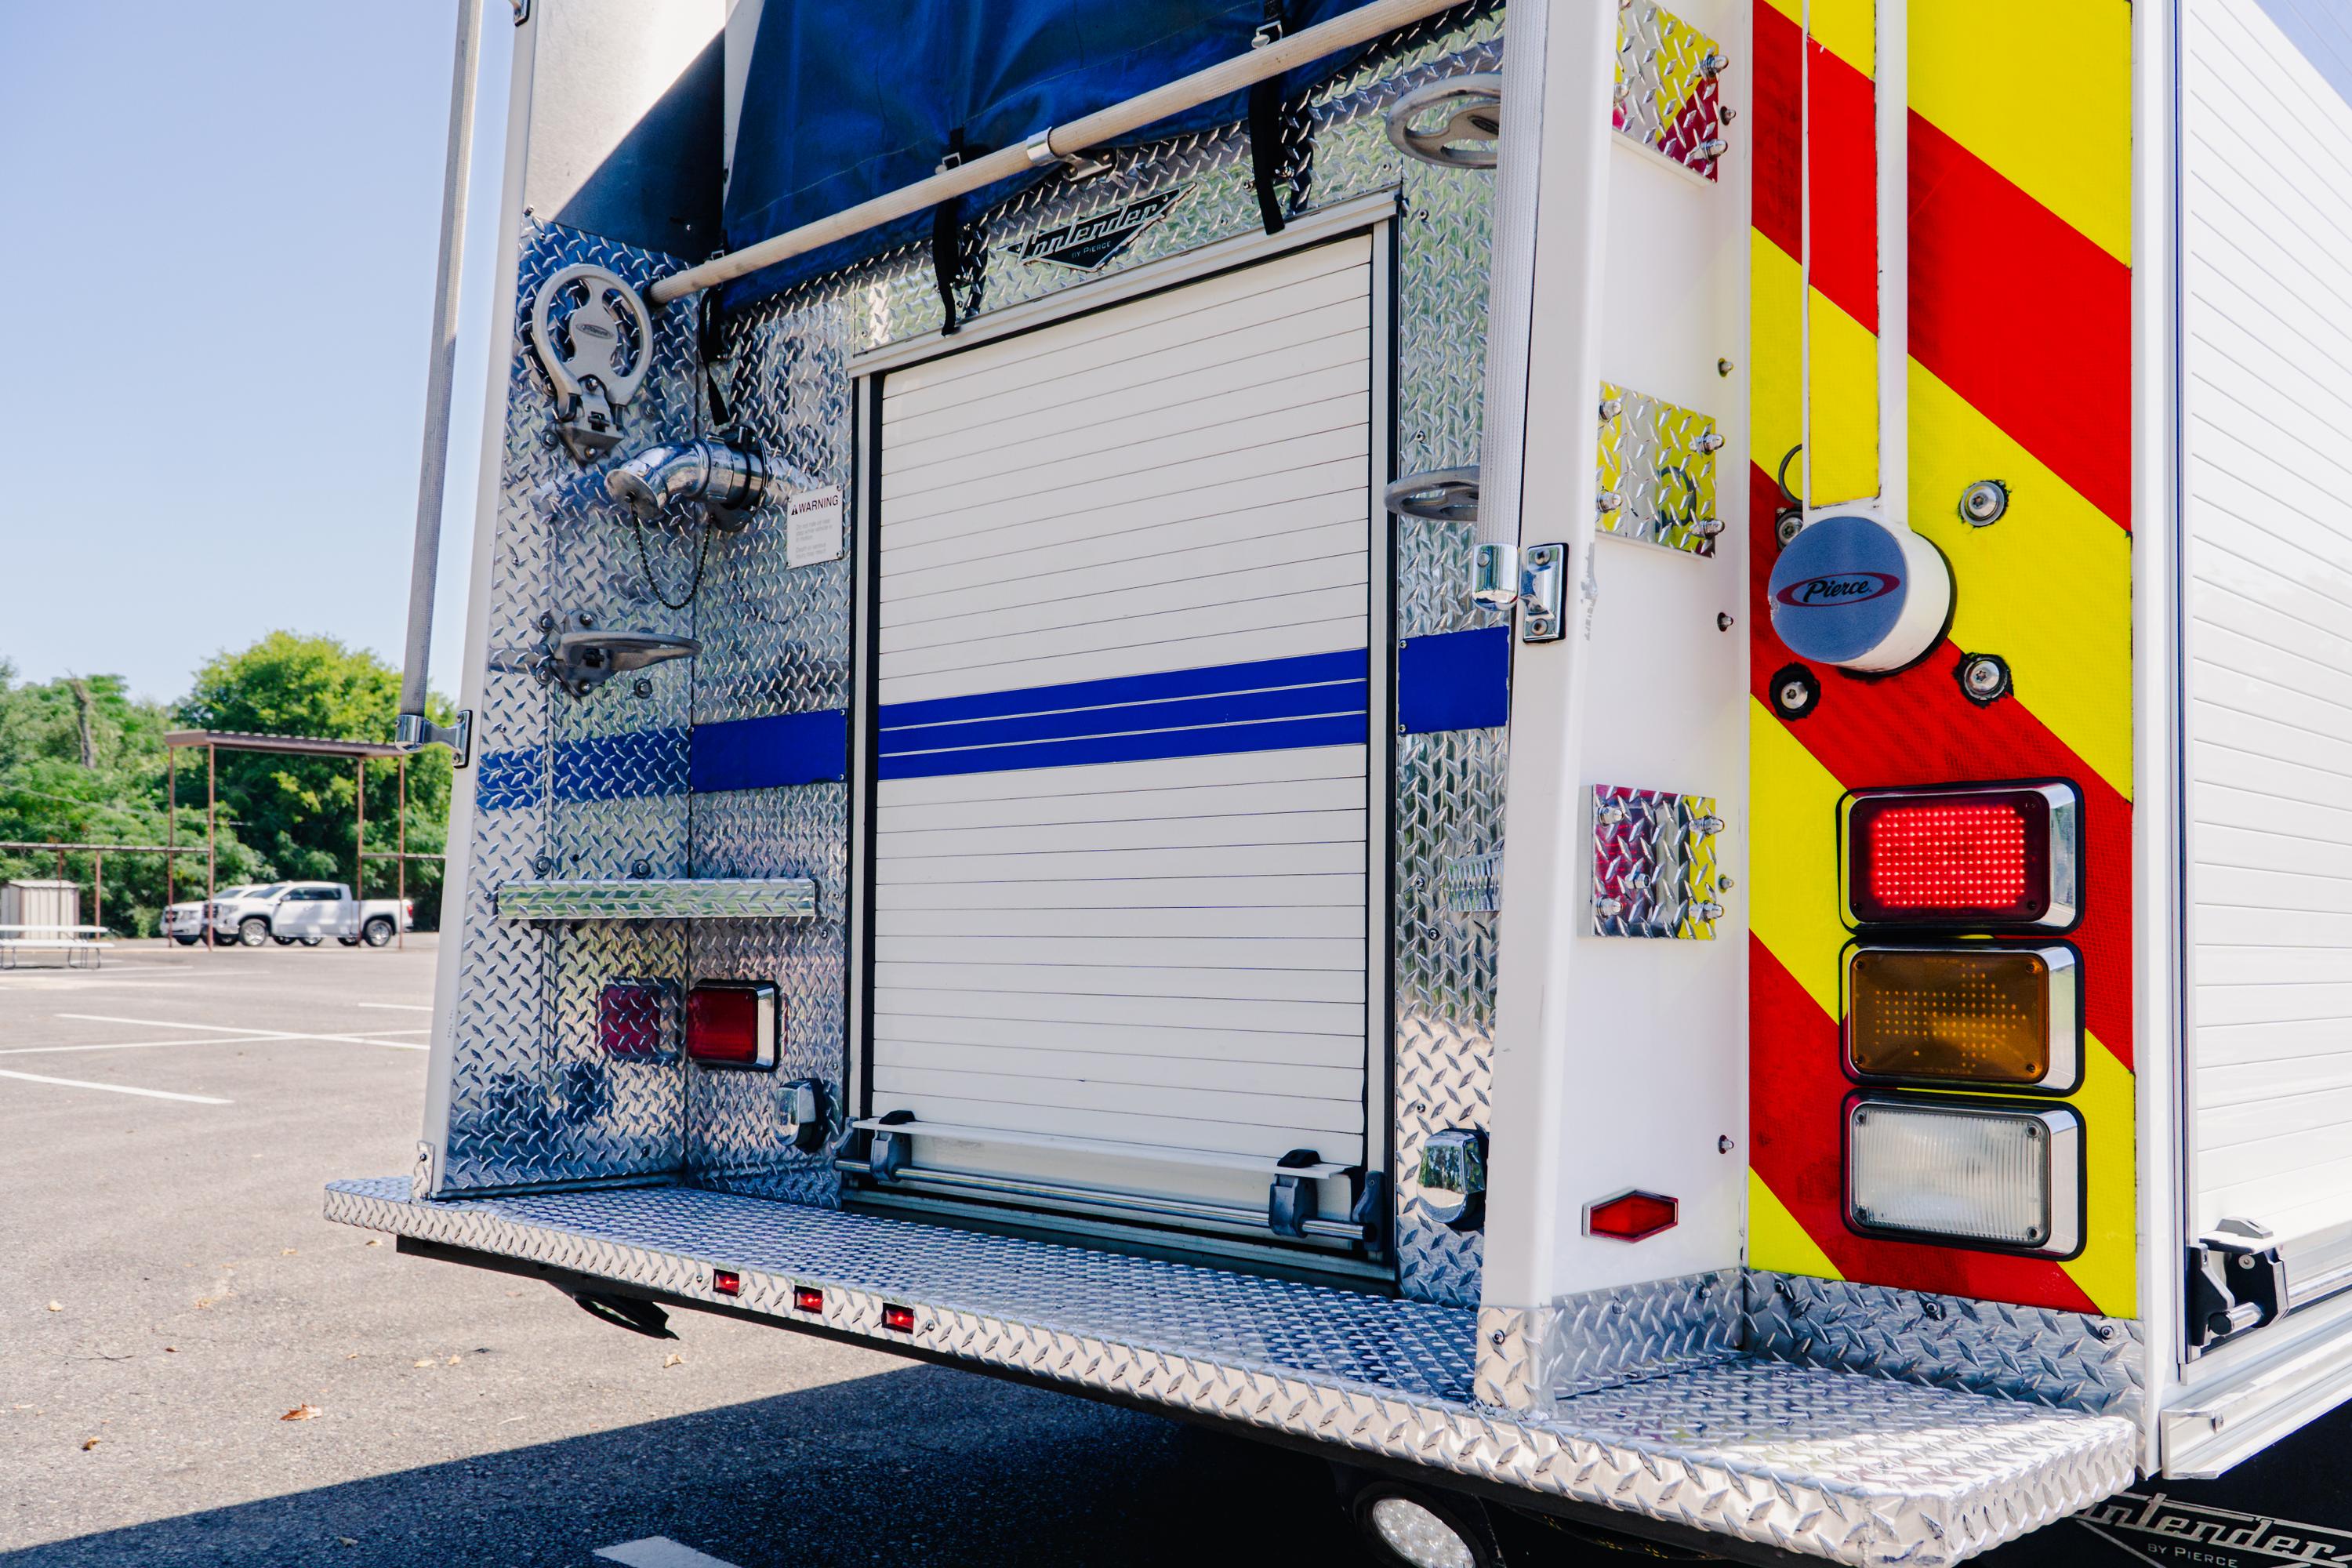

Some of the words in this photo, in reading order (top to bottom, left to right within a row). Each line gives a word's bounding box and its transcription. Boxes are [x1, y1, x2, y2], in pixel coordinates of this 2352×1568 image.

[1018, 203, 1158, 263] Contender
[799, 495, 839, 514] WARNING
[1803, 579, 1871, 603] Pierce
[2071, 1492, 2336, 1560] ntender
[2147, 1543, 2168, 1555] BY
